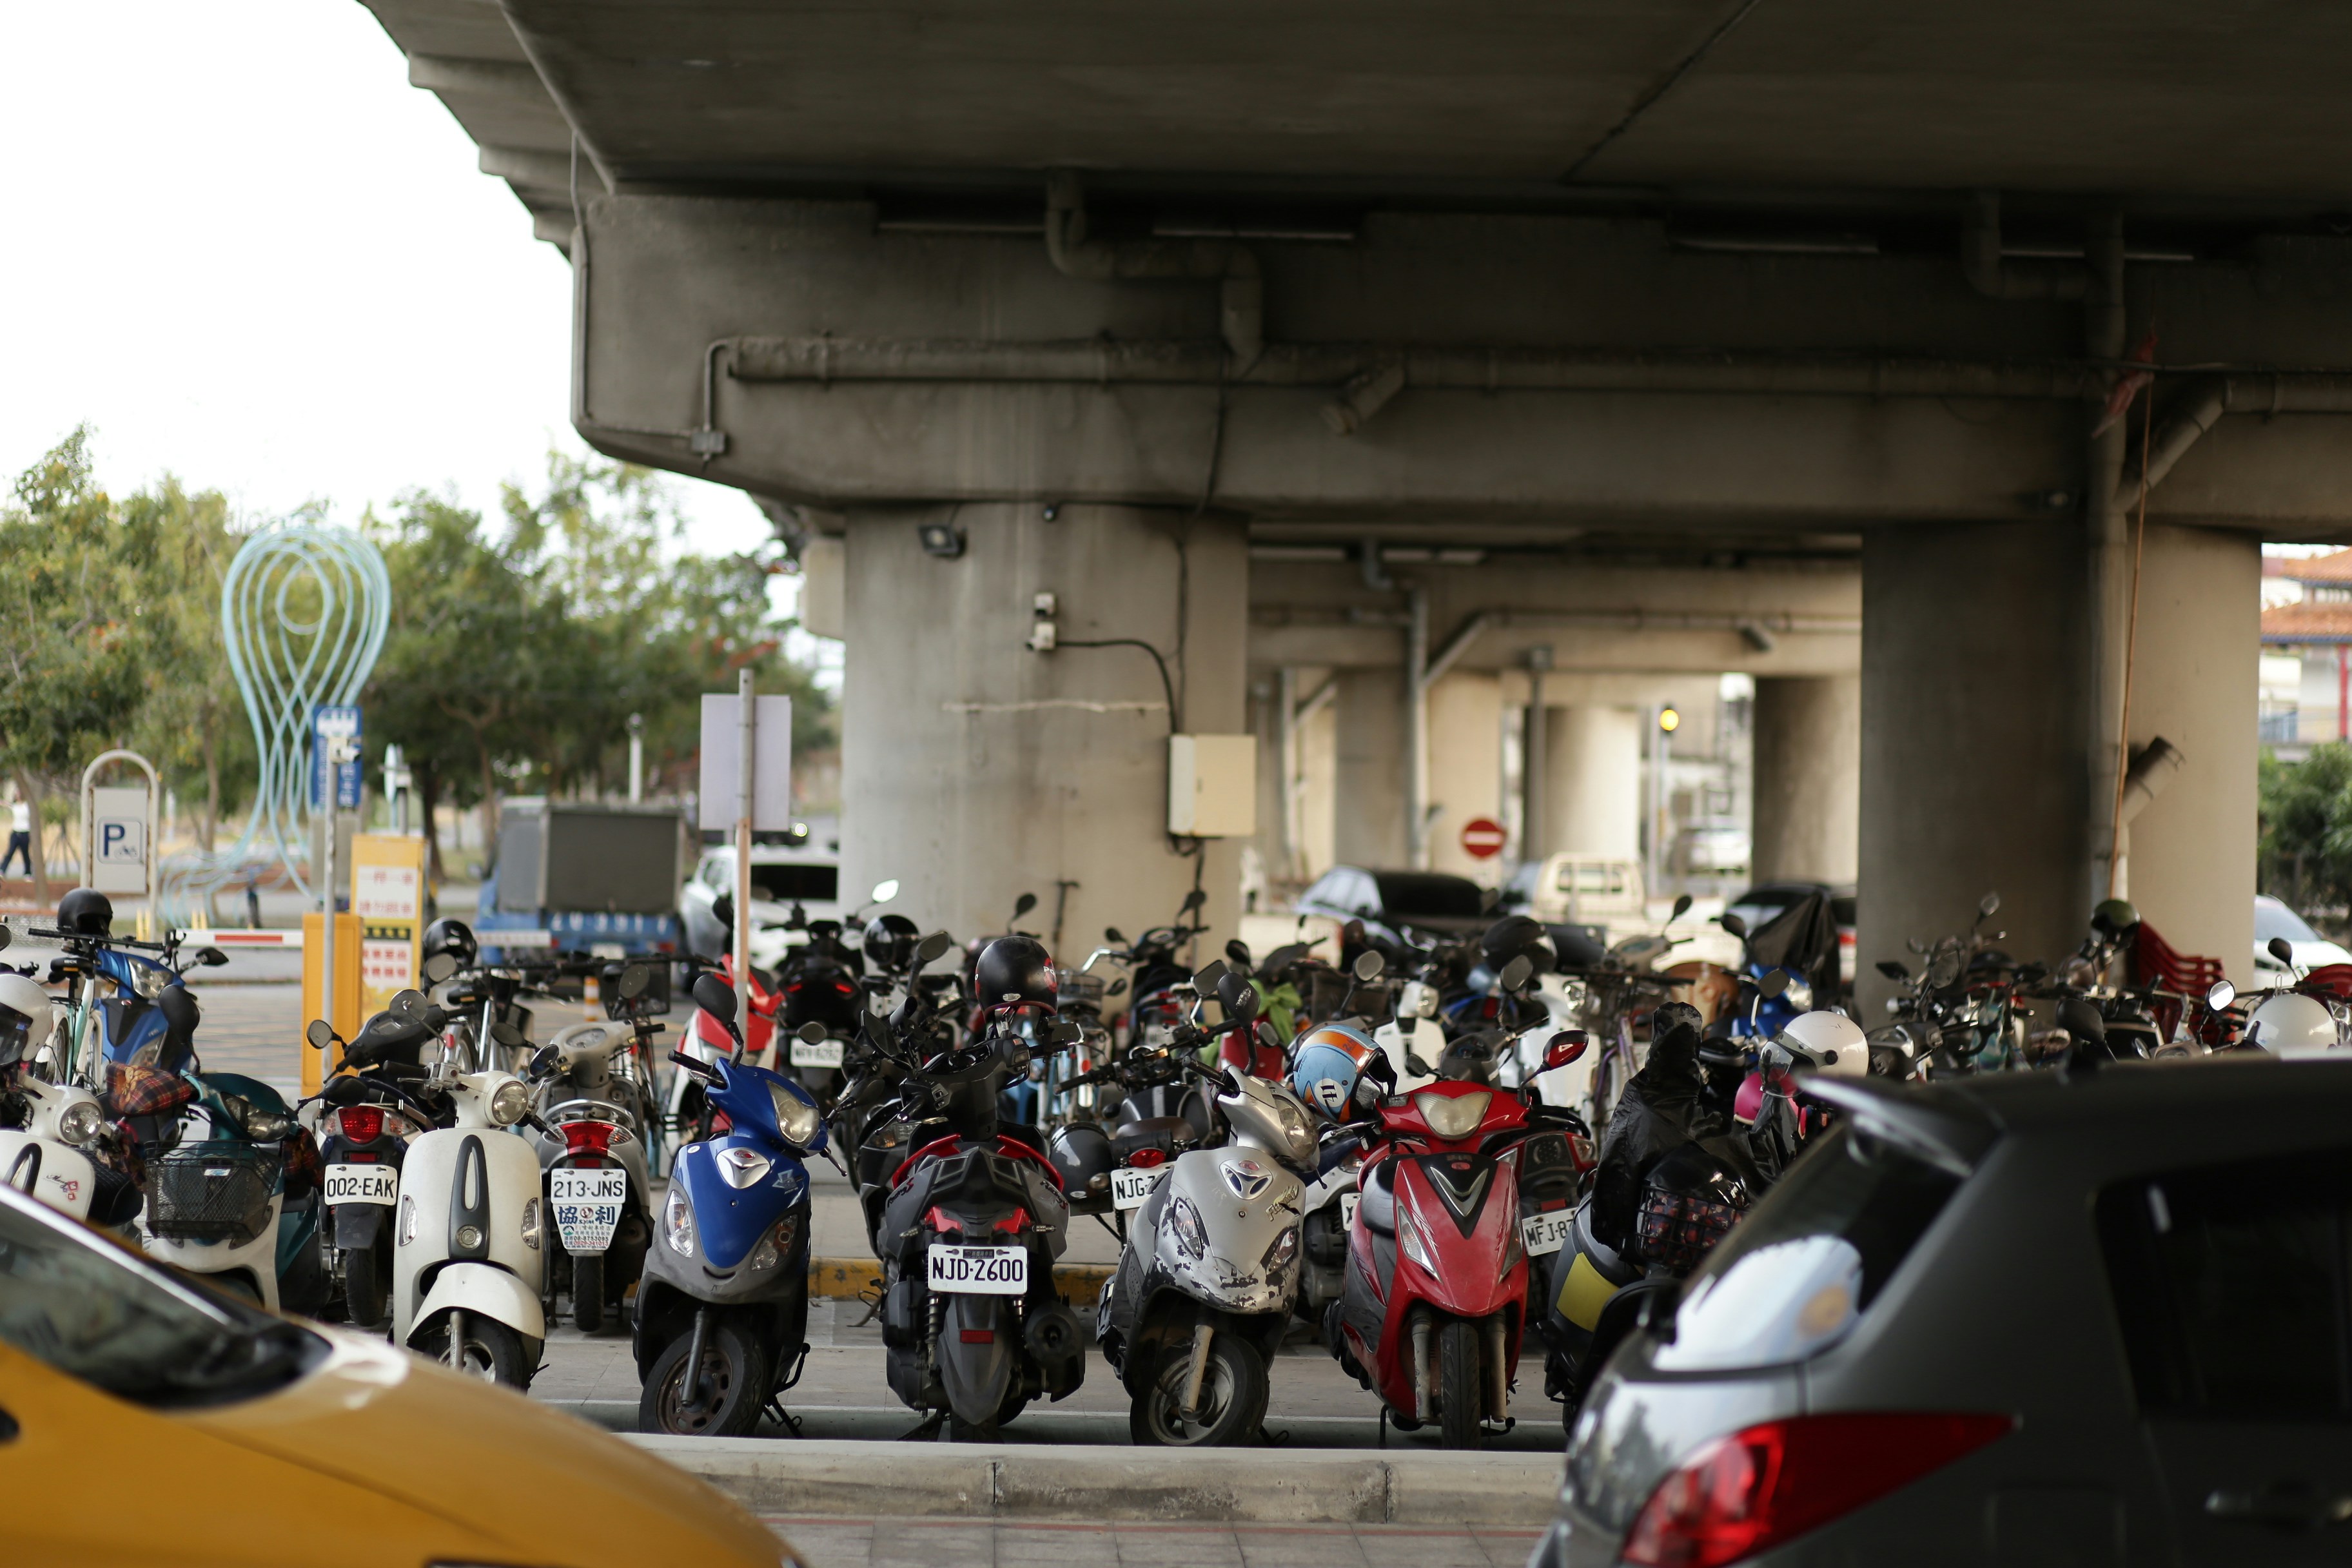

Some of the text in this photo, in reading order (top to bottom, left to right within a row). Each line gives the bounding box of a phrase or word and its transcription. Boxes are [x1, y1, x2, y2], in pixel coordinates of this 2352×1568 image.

[104, 823, 125, 857] P
[327, 1177, 395, 1199] 002-EAK
[554, 1181, 623, 1197] 213-JNS
[932, 1257, 1023, 1282] NJD-2600
